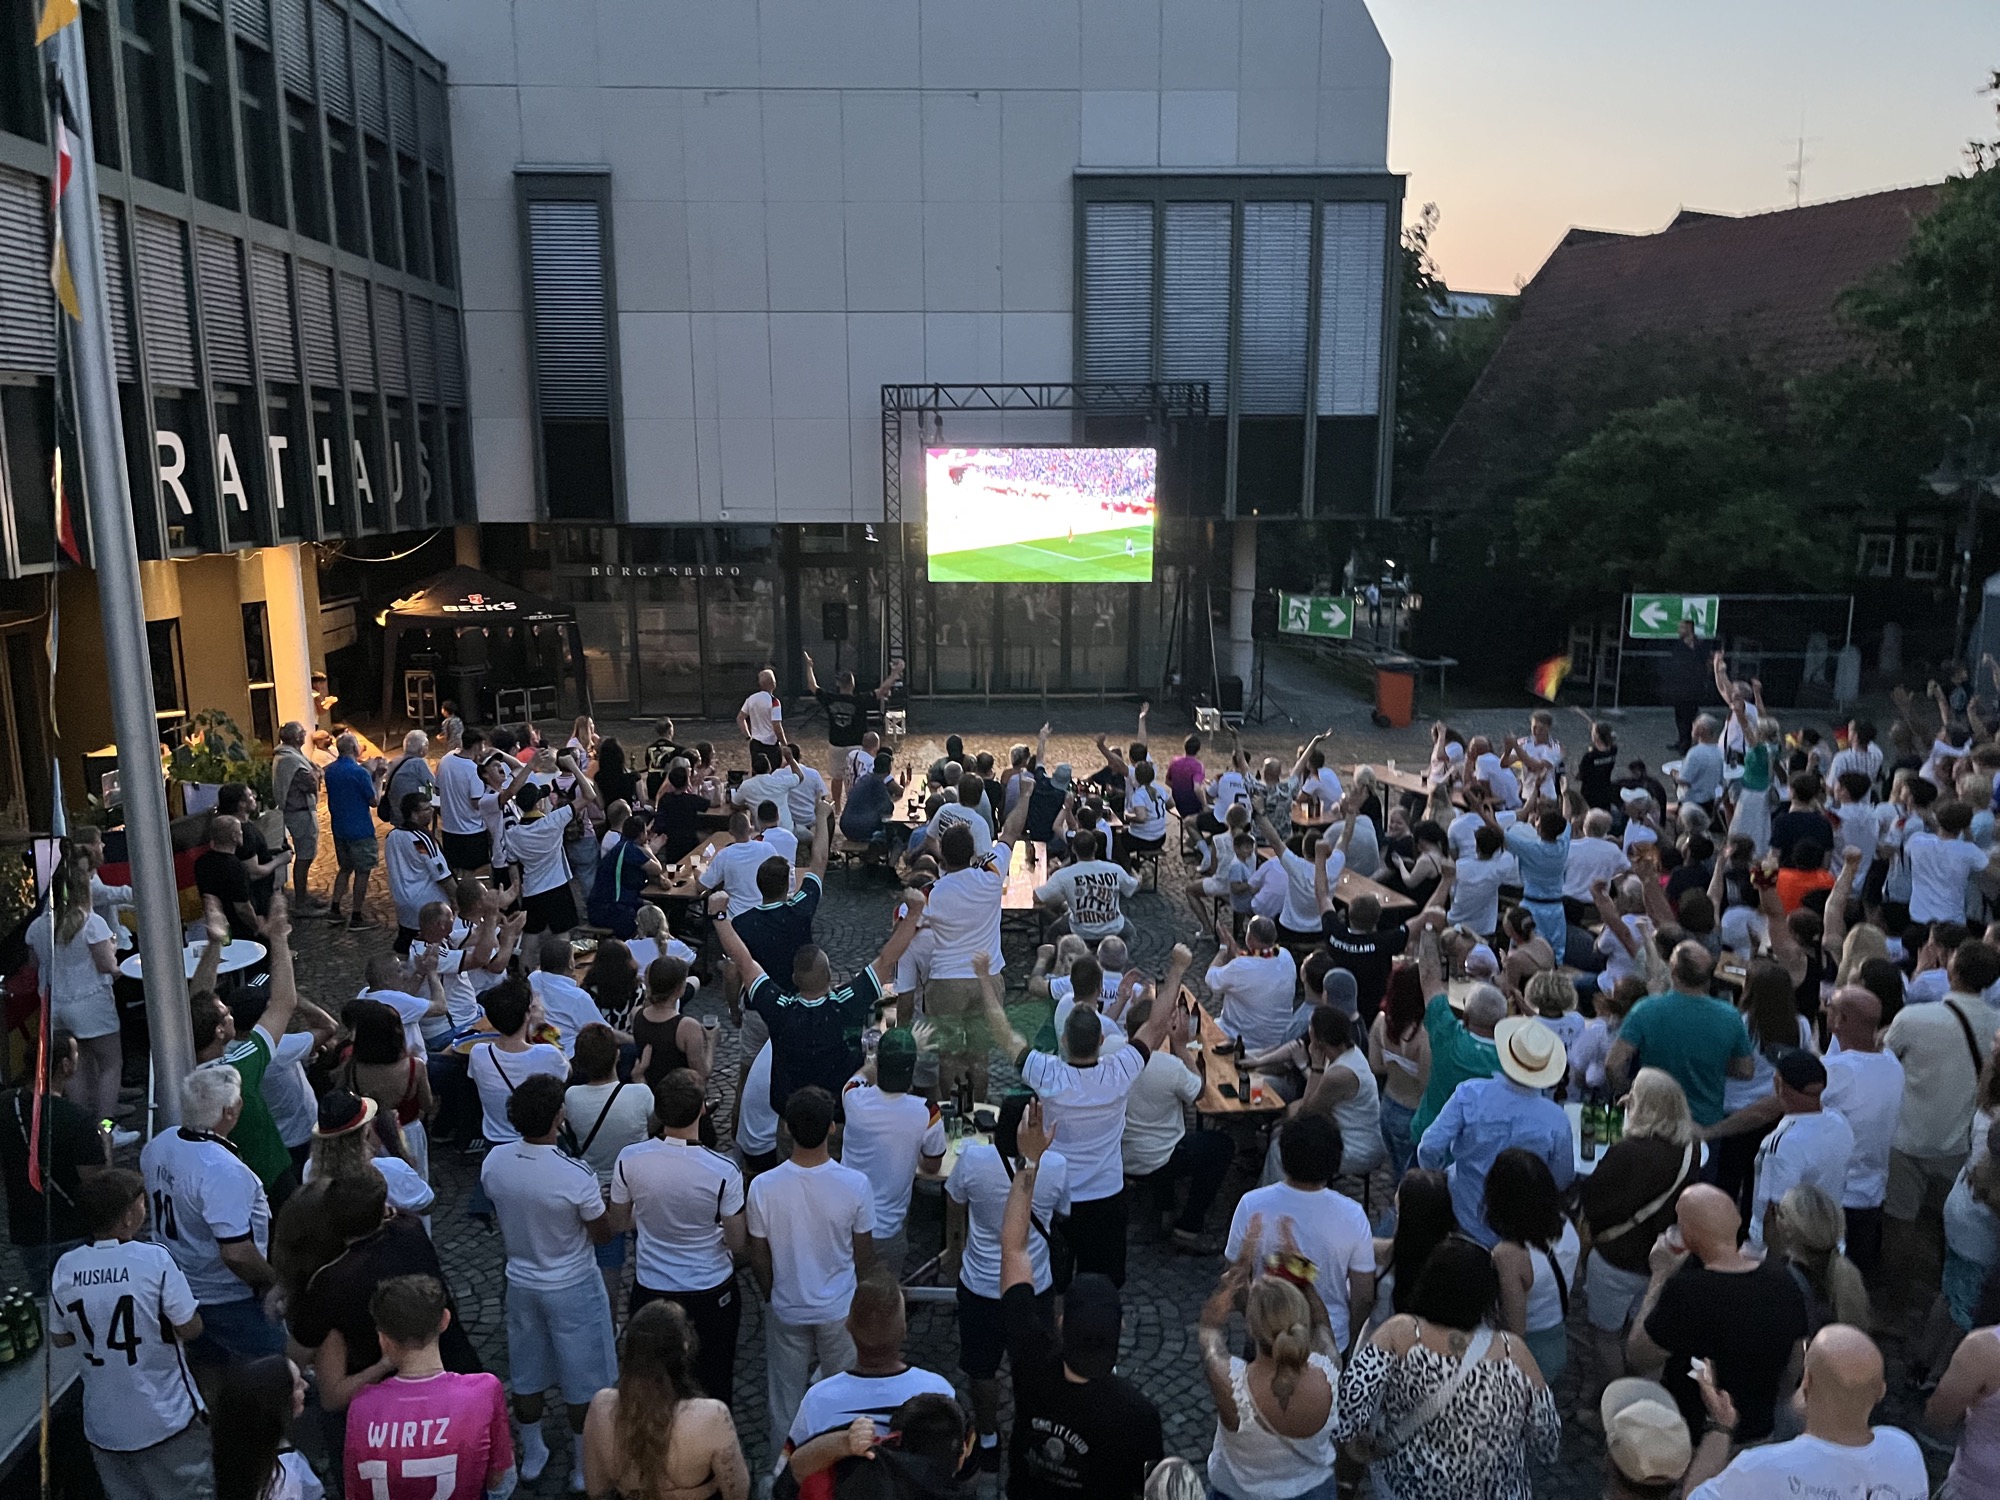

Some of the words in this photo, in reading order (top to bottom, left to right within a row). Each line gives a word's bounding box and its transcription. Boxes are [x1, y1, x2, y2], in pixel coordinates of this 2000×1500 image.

[156, 430, 432, 515] RATHAUS
[442, 602, 517, 612] BECK'S
[1074, 872, 1118, 887] ENJOY
[73, 1267, 130, 1287] MUSIALA
[66, 1294, 142, 1367] 14
[367, 1417, 451, 1448] WIRTZ
